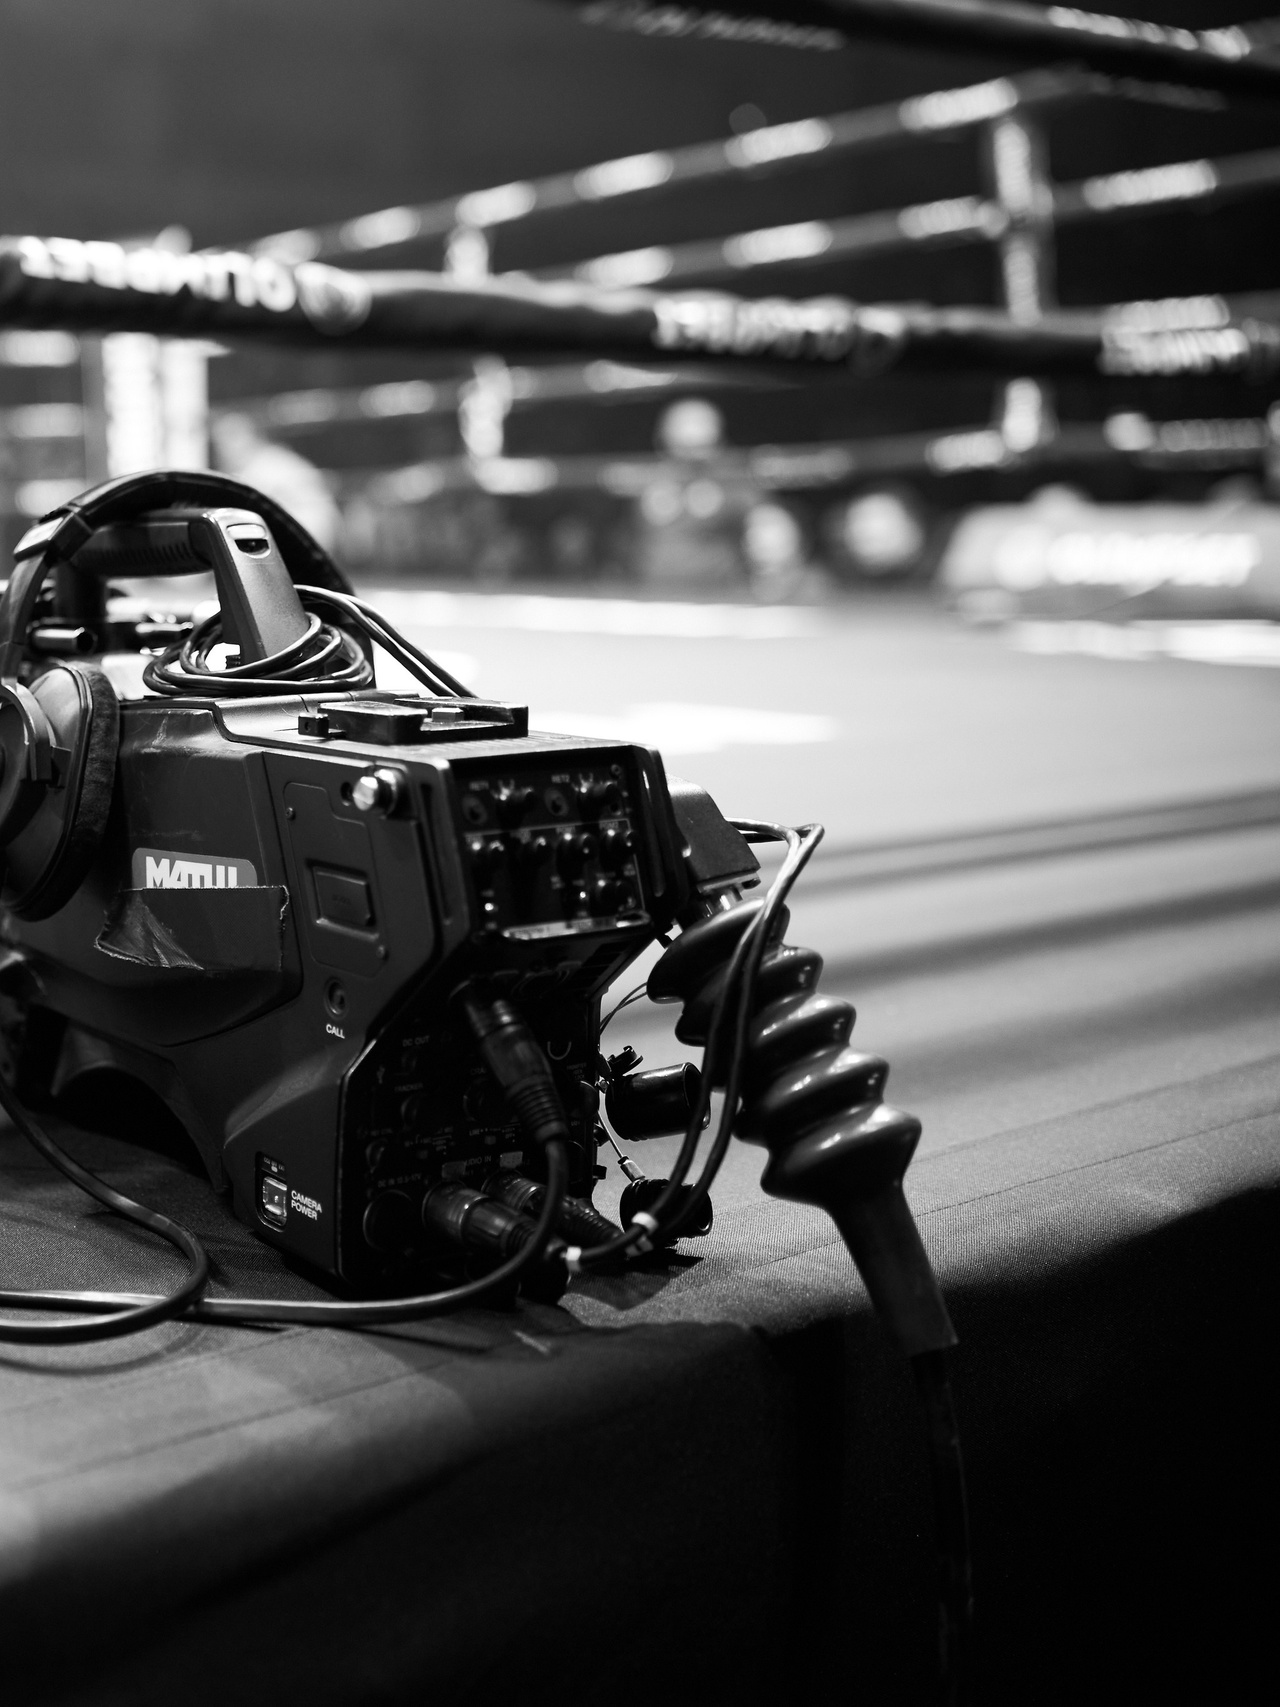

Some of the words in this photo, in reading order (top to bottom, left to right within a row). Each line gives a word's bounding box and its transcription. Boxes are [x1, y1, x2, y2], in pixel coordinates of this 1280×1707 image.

[325, 1023, 345, 1039] CALL
[402, 1038, 413, 1048] DC
[414, 1035, 430, 1046] OUT
[484, 1155, 492, 1163] IN
[291, 1190, 323, 1213] CAMERA
[291, 1200, 318, 1221] POWER
